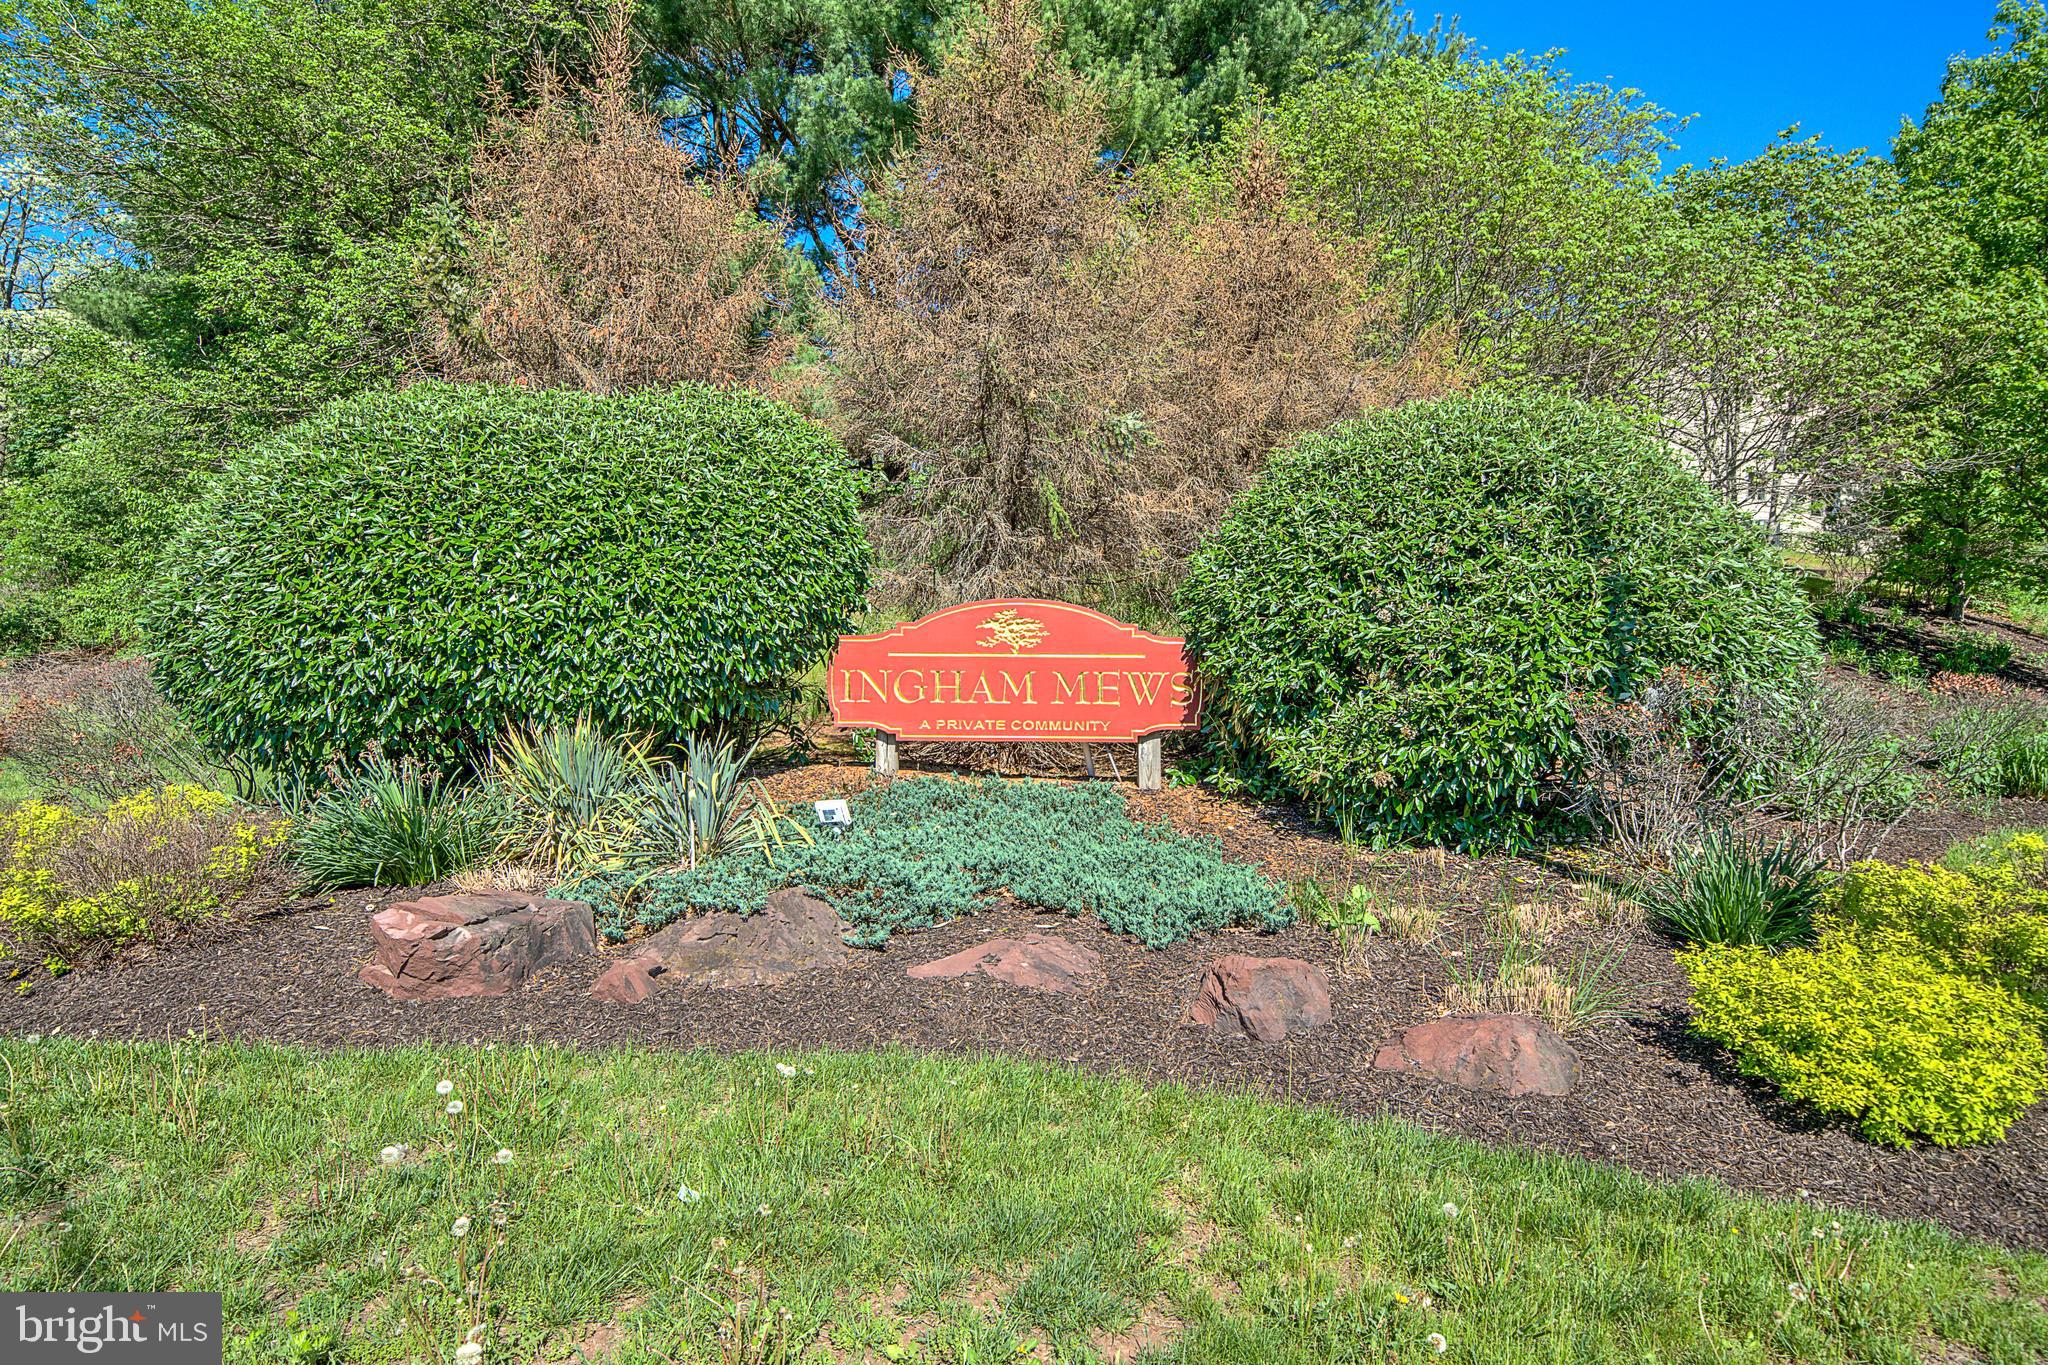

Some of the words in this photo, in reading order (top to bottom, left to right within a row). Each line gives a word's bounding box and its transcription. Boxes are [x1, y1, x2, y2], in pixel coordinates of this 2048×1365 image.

[839, 669, 1037, 705] INGHAM
[1051, 671, 1194, 707] MEWS
[919, 720, 931, 730] A
[935, 720, 1006, 731] PRIVATE
[1010, 720, 1111, 731] COMMUNITY
